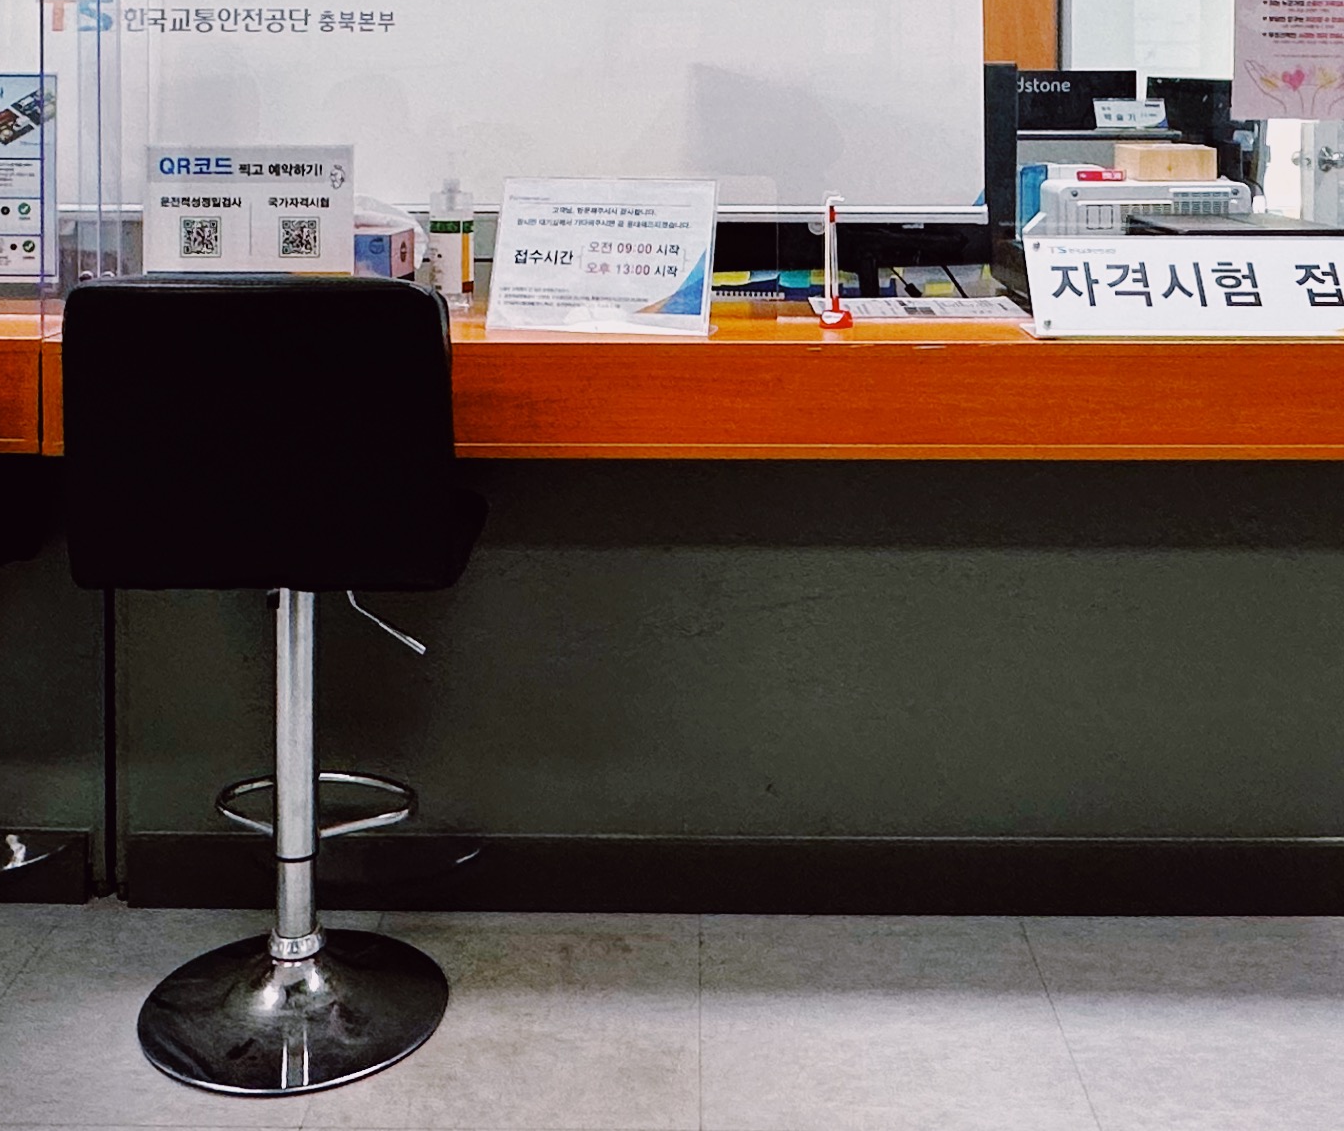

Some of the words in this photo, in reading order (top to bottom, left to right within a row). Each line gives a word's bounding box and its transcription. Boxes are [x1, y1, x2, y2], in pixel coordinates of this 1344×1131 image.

[123, 7, 311, 34] 한국교통안전공단
[318, 10, 397, 34] 충북본부
[158, 157, 234, 176] QR코드
[238, 163, 264, 177] 찍고
[267, 163, 323, 177] 예약하기!
[513, 249, 574, 267] 접수시간
[616, 242, 653, 256] 09:00
[655, 244, 681, 257] 시작
[615, 263, 651, 277] 13:00
[653, 264, 679, 278] 시작
[1050, 260, 1264, 308] 자격시험
